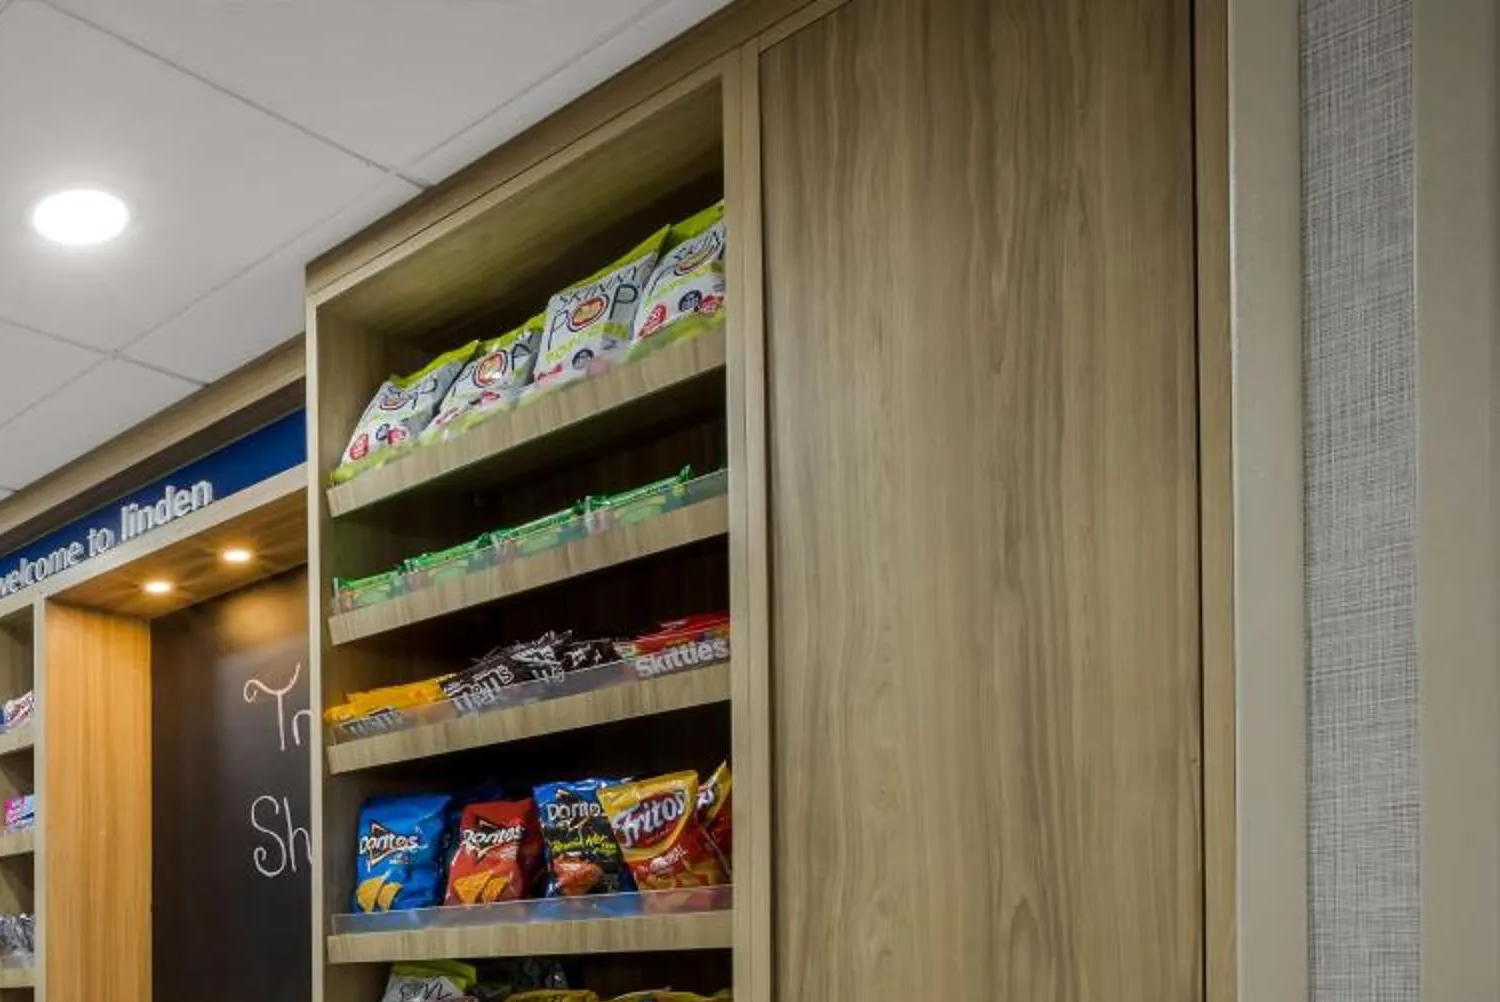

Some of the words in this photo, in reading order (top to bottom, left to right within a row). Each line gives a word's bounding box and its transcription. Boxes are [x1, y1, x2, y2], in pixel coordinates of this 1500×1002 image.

[87, 527, 117, 558] to
[121, 478, 213, 541] linden
[635, 638, 729, 678] Skittles
[461, 825, 524, 846] Doritos
[611, 790, 687, 848] Fritos
[359, 834, 420, 854] Doritos
